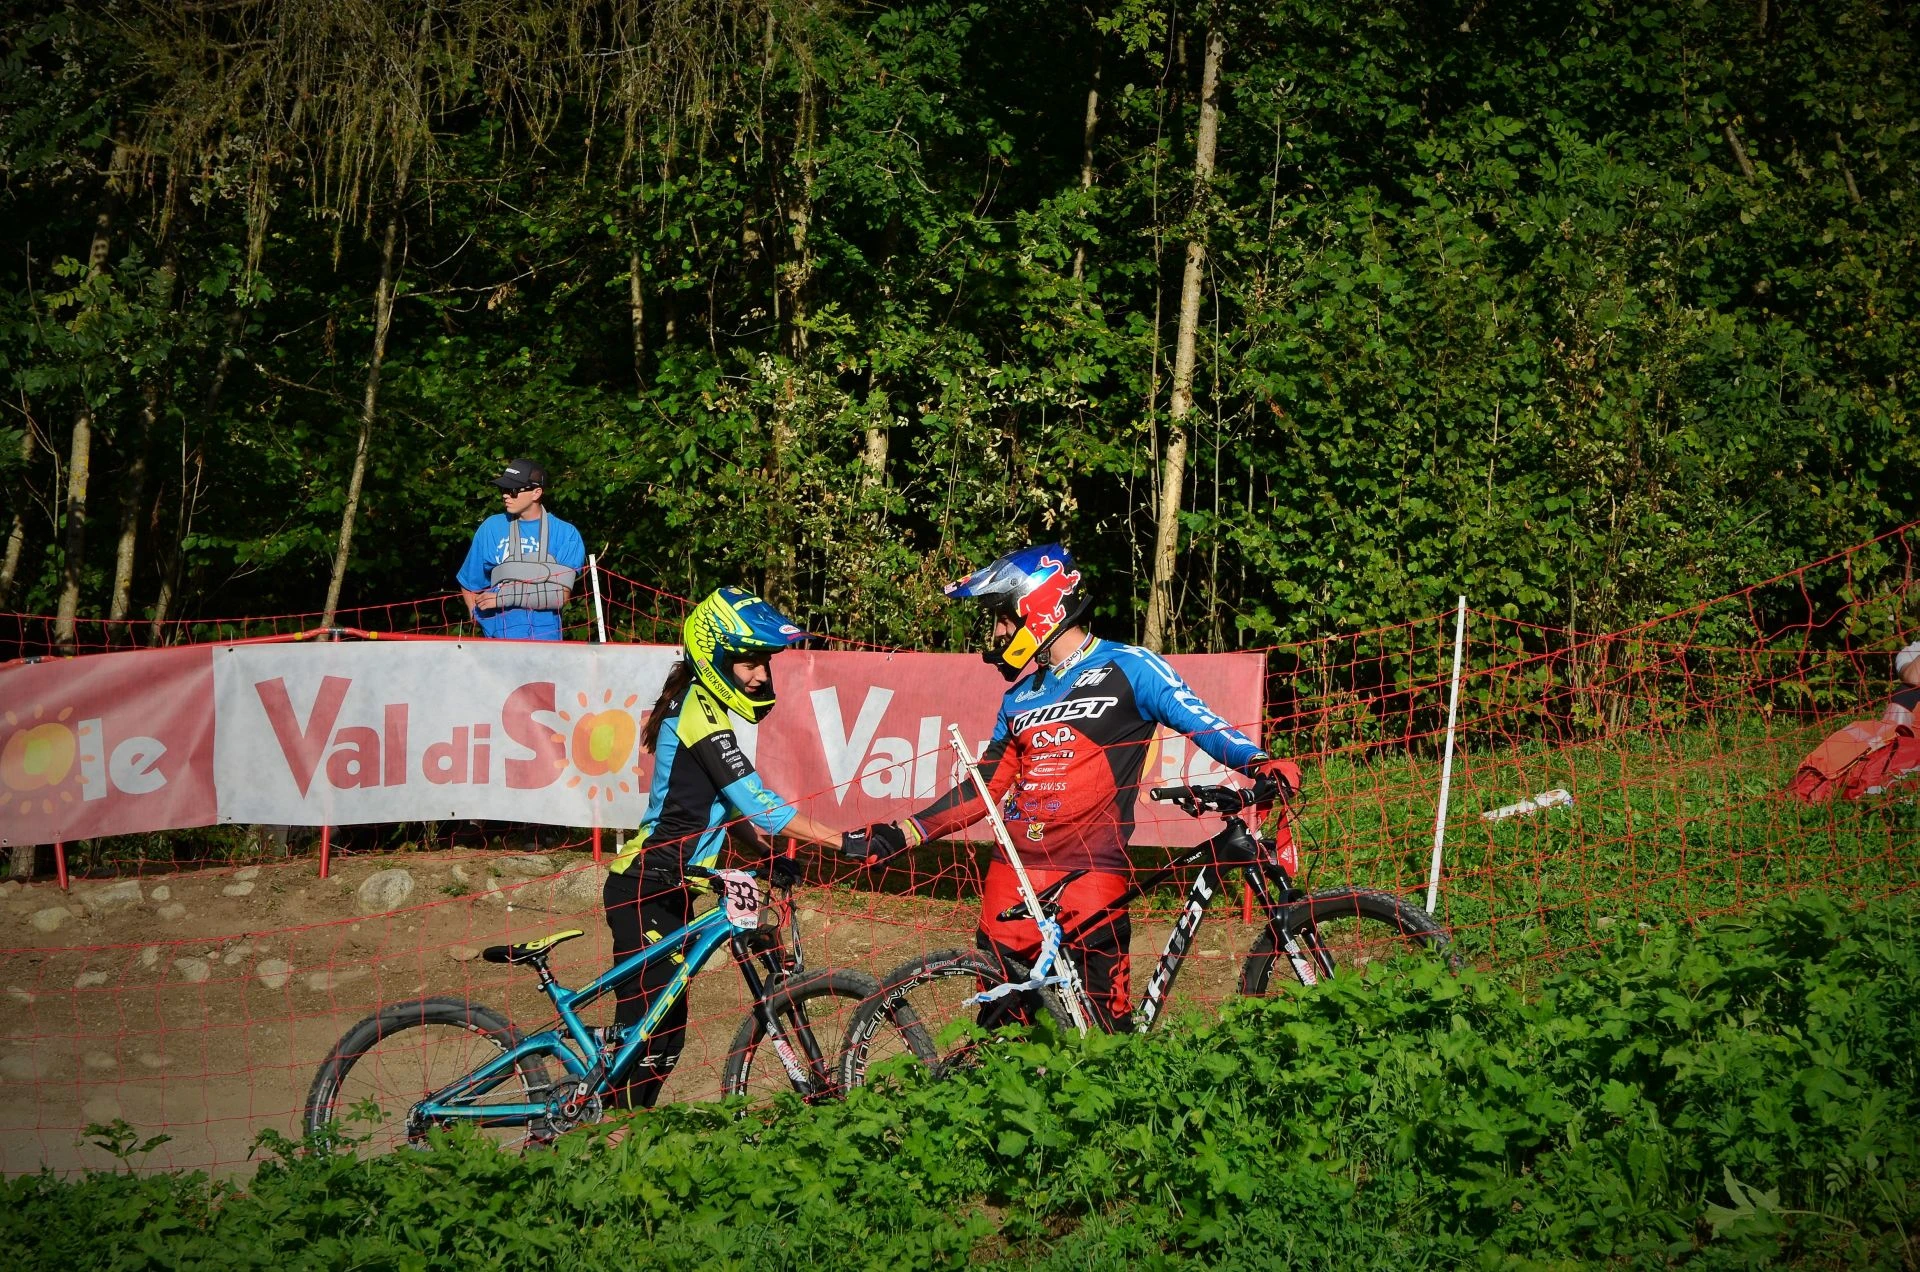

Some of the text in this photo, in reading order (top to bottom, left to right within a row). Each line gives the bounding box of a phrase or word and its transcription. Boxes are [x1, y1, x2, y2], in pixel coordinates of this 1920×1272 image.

[703, 666, 733, 701] ROCKSHOX
[1013, 697, 1118, 736] GHOST
[255, 675, 408, 799] Val
[422, 723, 490, 784] di
[810, 686, 942, 806] Val
[730, 881, 757, 911] 33
